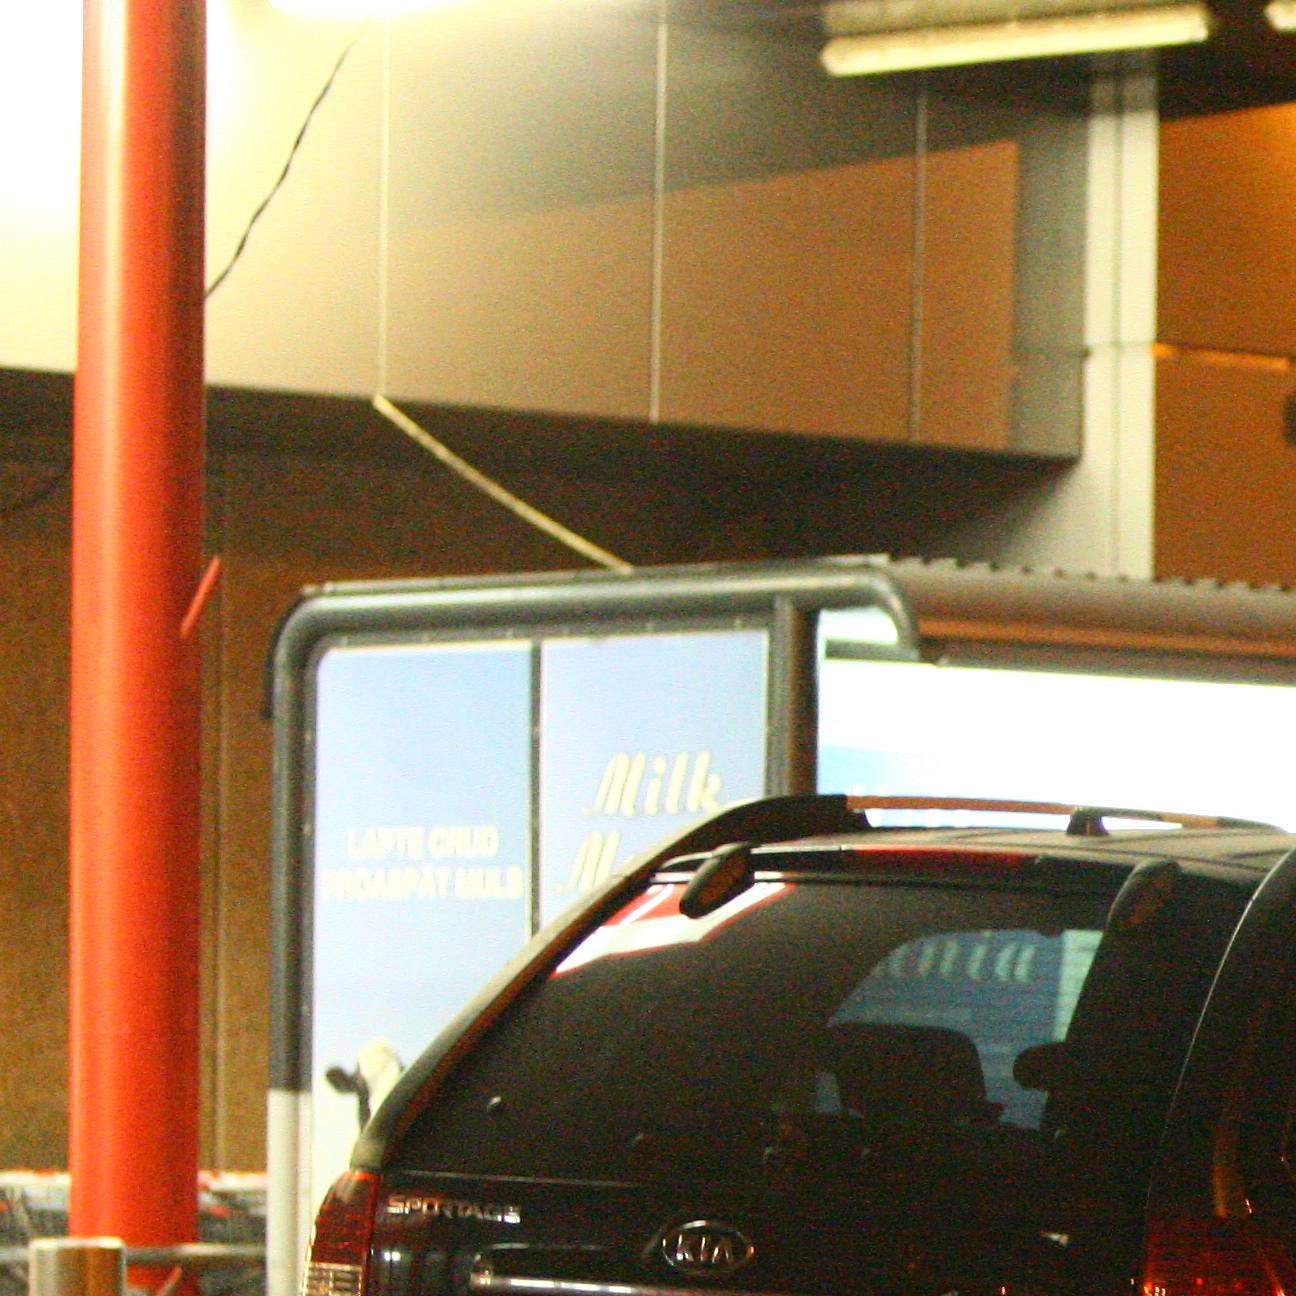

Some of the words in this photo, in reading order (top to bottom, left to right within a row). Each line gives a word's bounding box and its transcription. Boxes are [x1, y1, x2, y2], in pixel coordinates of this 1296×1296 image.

[579, 747, 724, 818] Milk
[346, 824, 424, 860] LAPTE
[428, 823, 499, 859] CRUD
[671, 1231, 733, 1264] KIA
